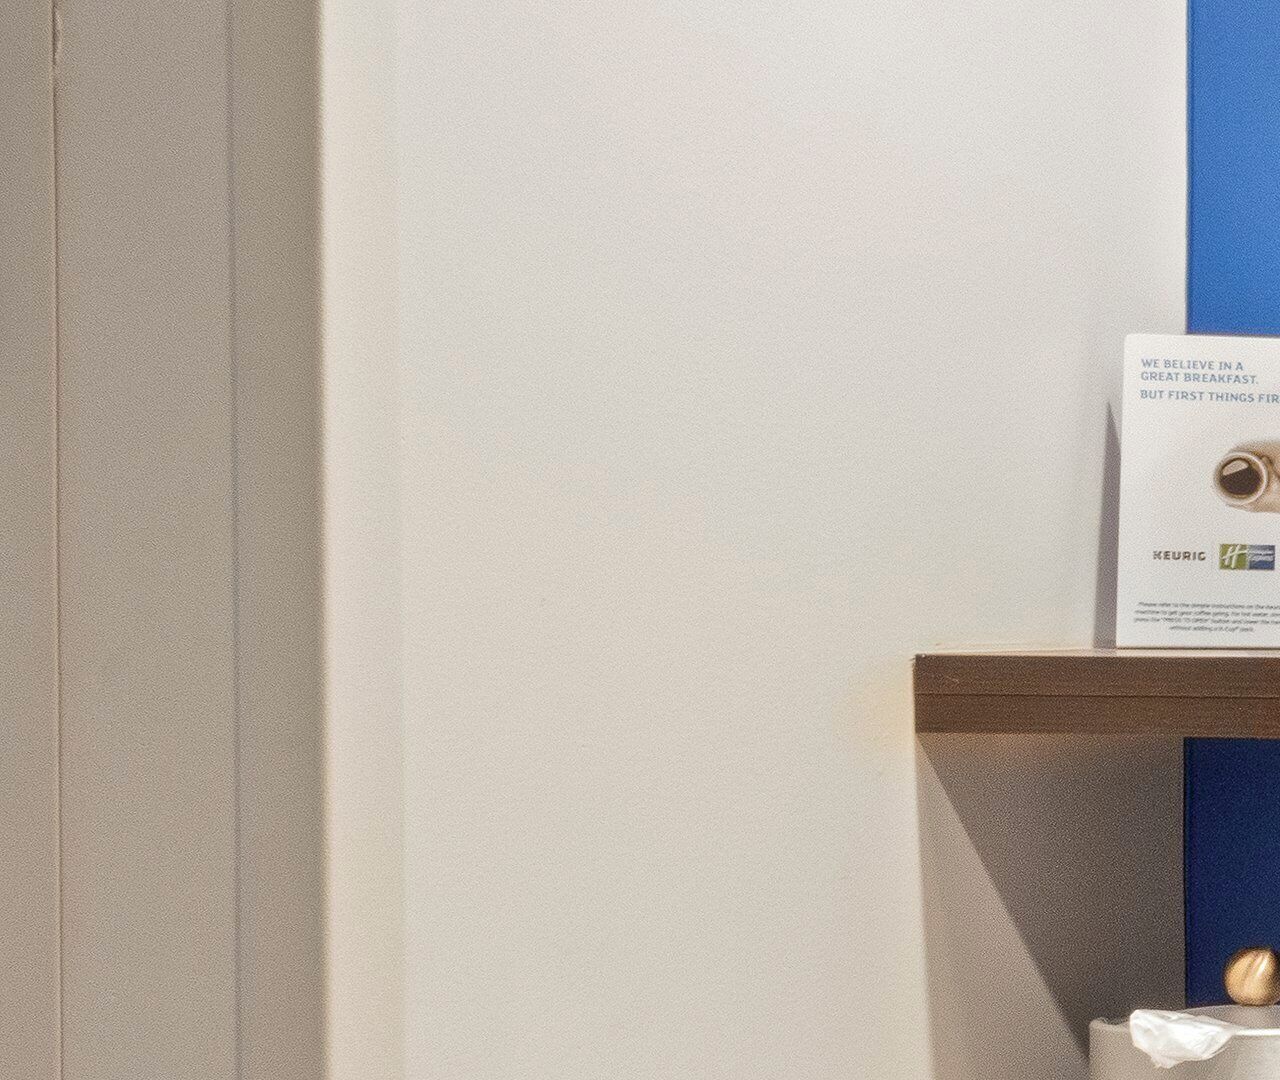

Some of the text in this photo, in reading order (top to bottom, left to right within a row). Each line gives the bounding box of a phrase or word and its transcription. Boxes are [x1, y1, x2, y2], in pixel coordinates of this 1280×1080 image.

[1141, 358, 1244, 371] WE BELIEVE IN A
[1141, 372, 1259, 385] GREAT BREAKFAST.
[1141, 389, 1165, 400] BUT
[1168, 390, 1205, 401] FIRST
[1208, 392, 1255, 403] THINGS
[1153, 550, 1207, 561] KEURIG
